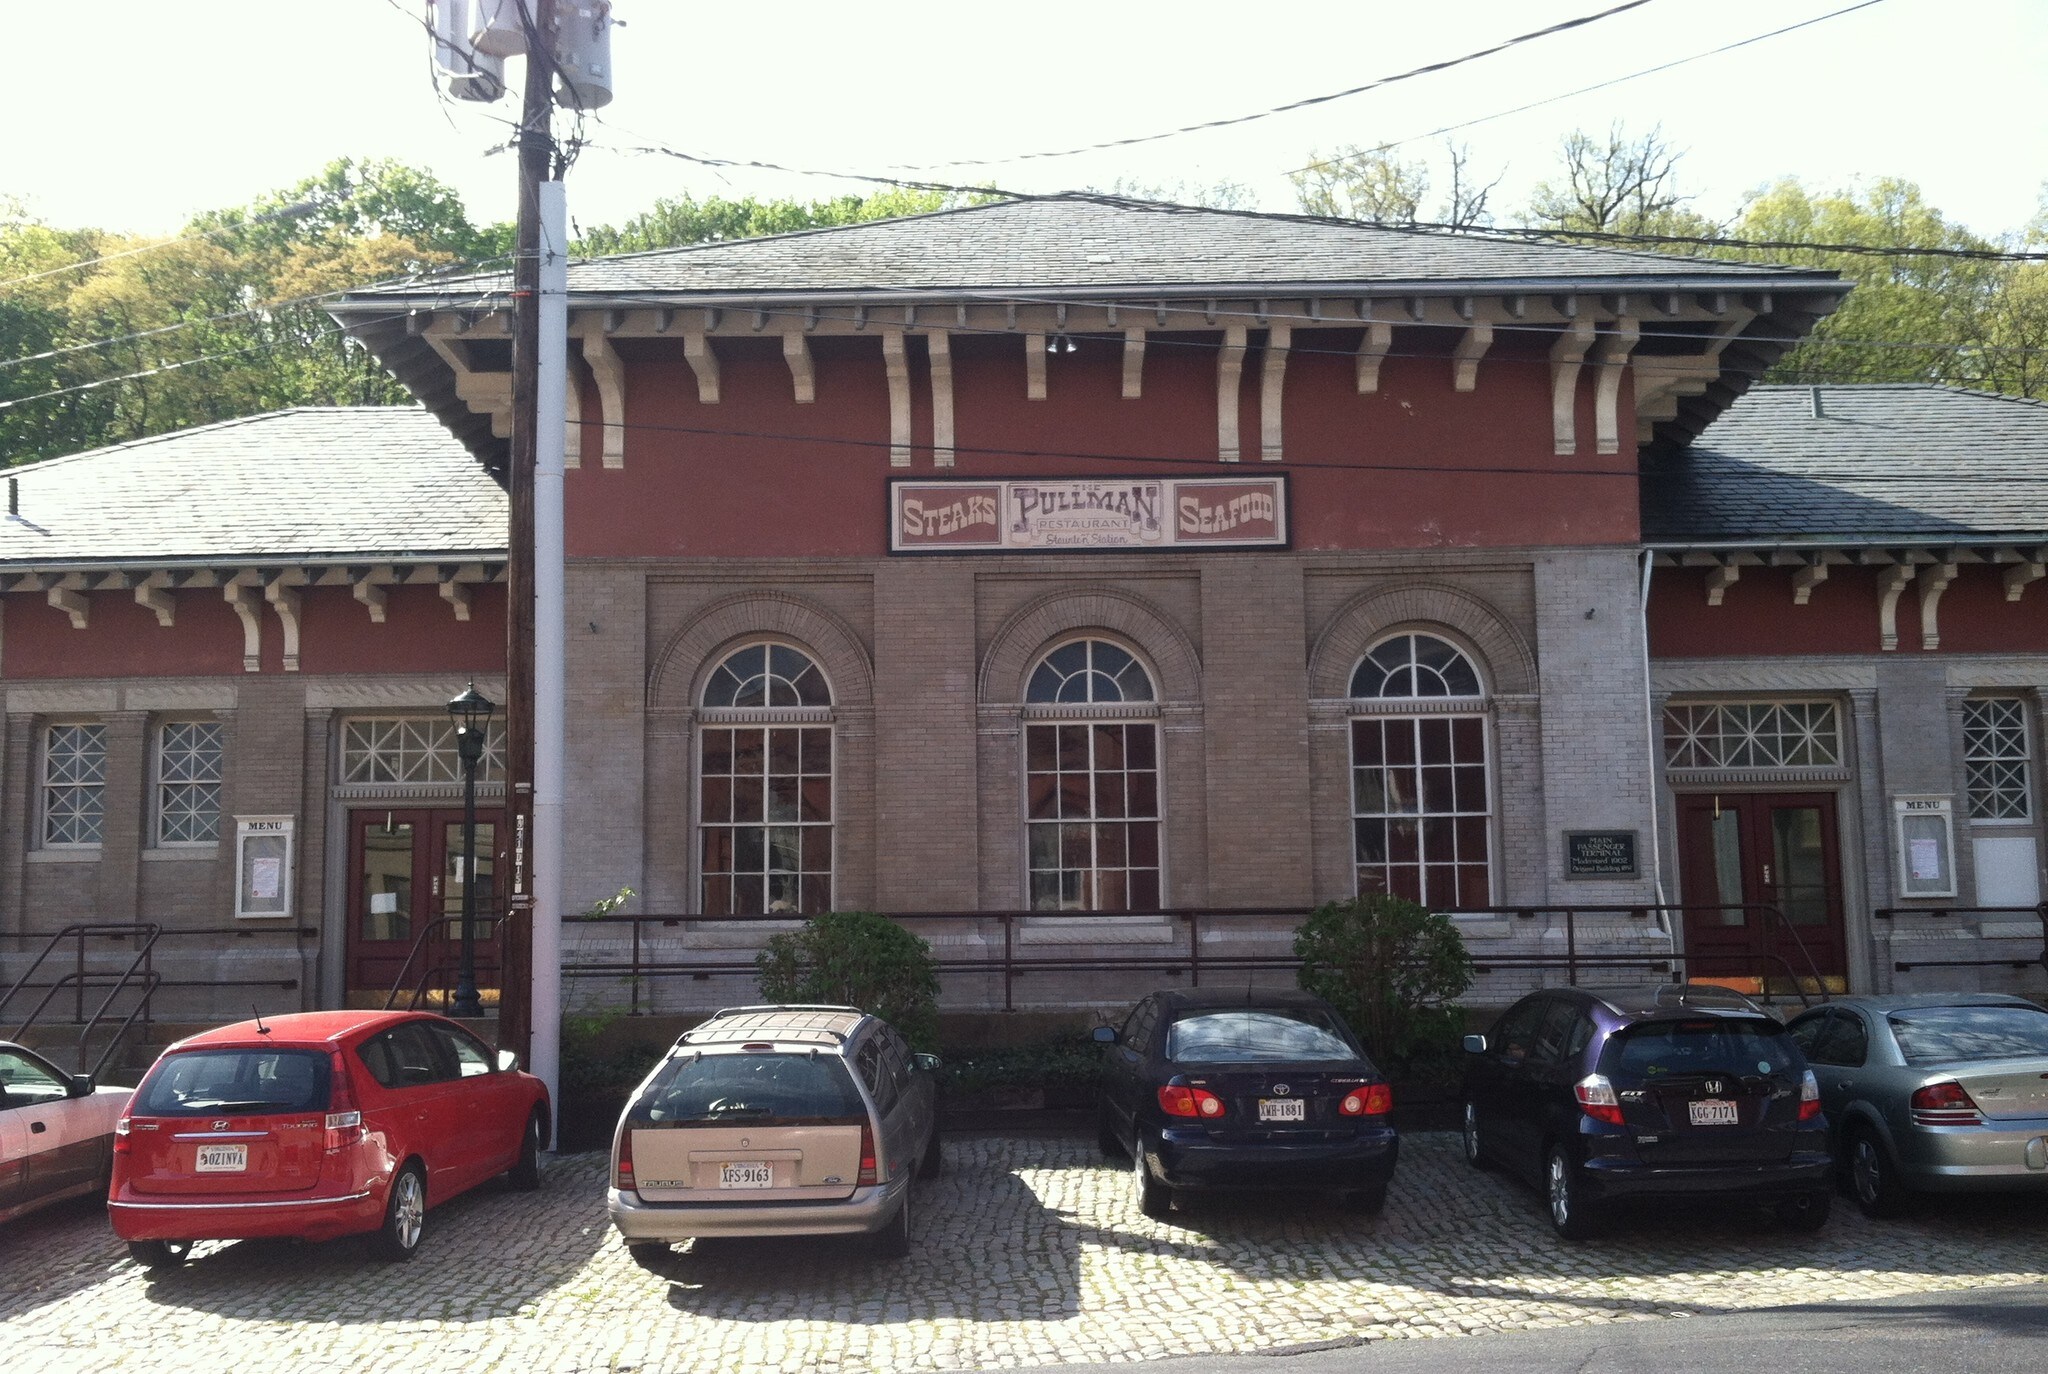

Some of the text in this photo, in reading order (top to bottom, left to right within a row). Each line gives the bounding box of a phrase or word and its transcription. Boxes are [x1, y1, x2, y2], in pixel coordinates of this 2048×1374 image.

[903, 496, 996, 537] STEAKS
[1013, 487, 1158, 533] PULLMAN
[1180, 492, 1273, 534] SEAFOOD
[1039, 518, 1128, 530] RESTAURANT
[1906, 801, 1940, 809] MENU
[248, 822, 282, 830] MENU
